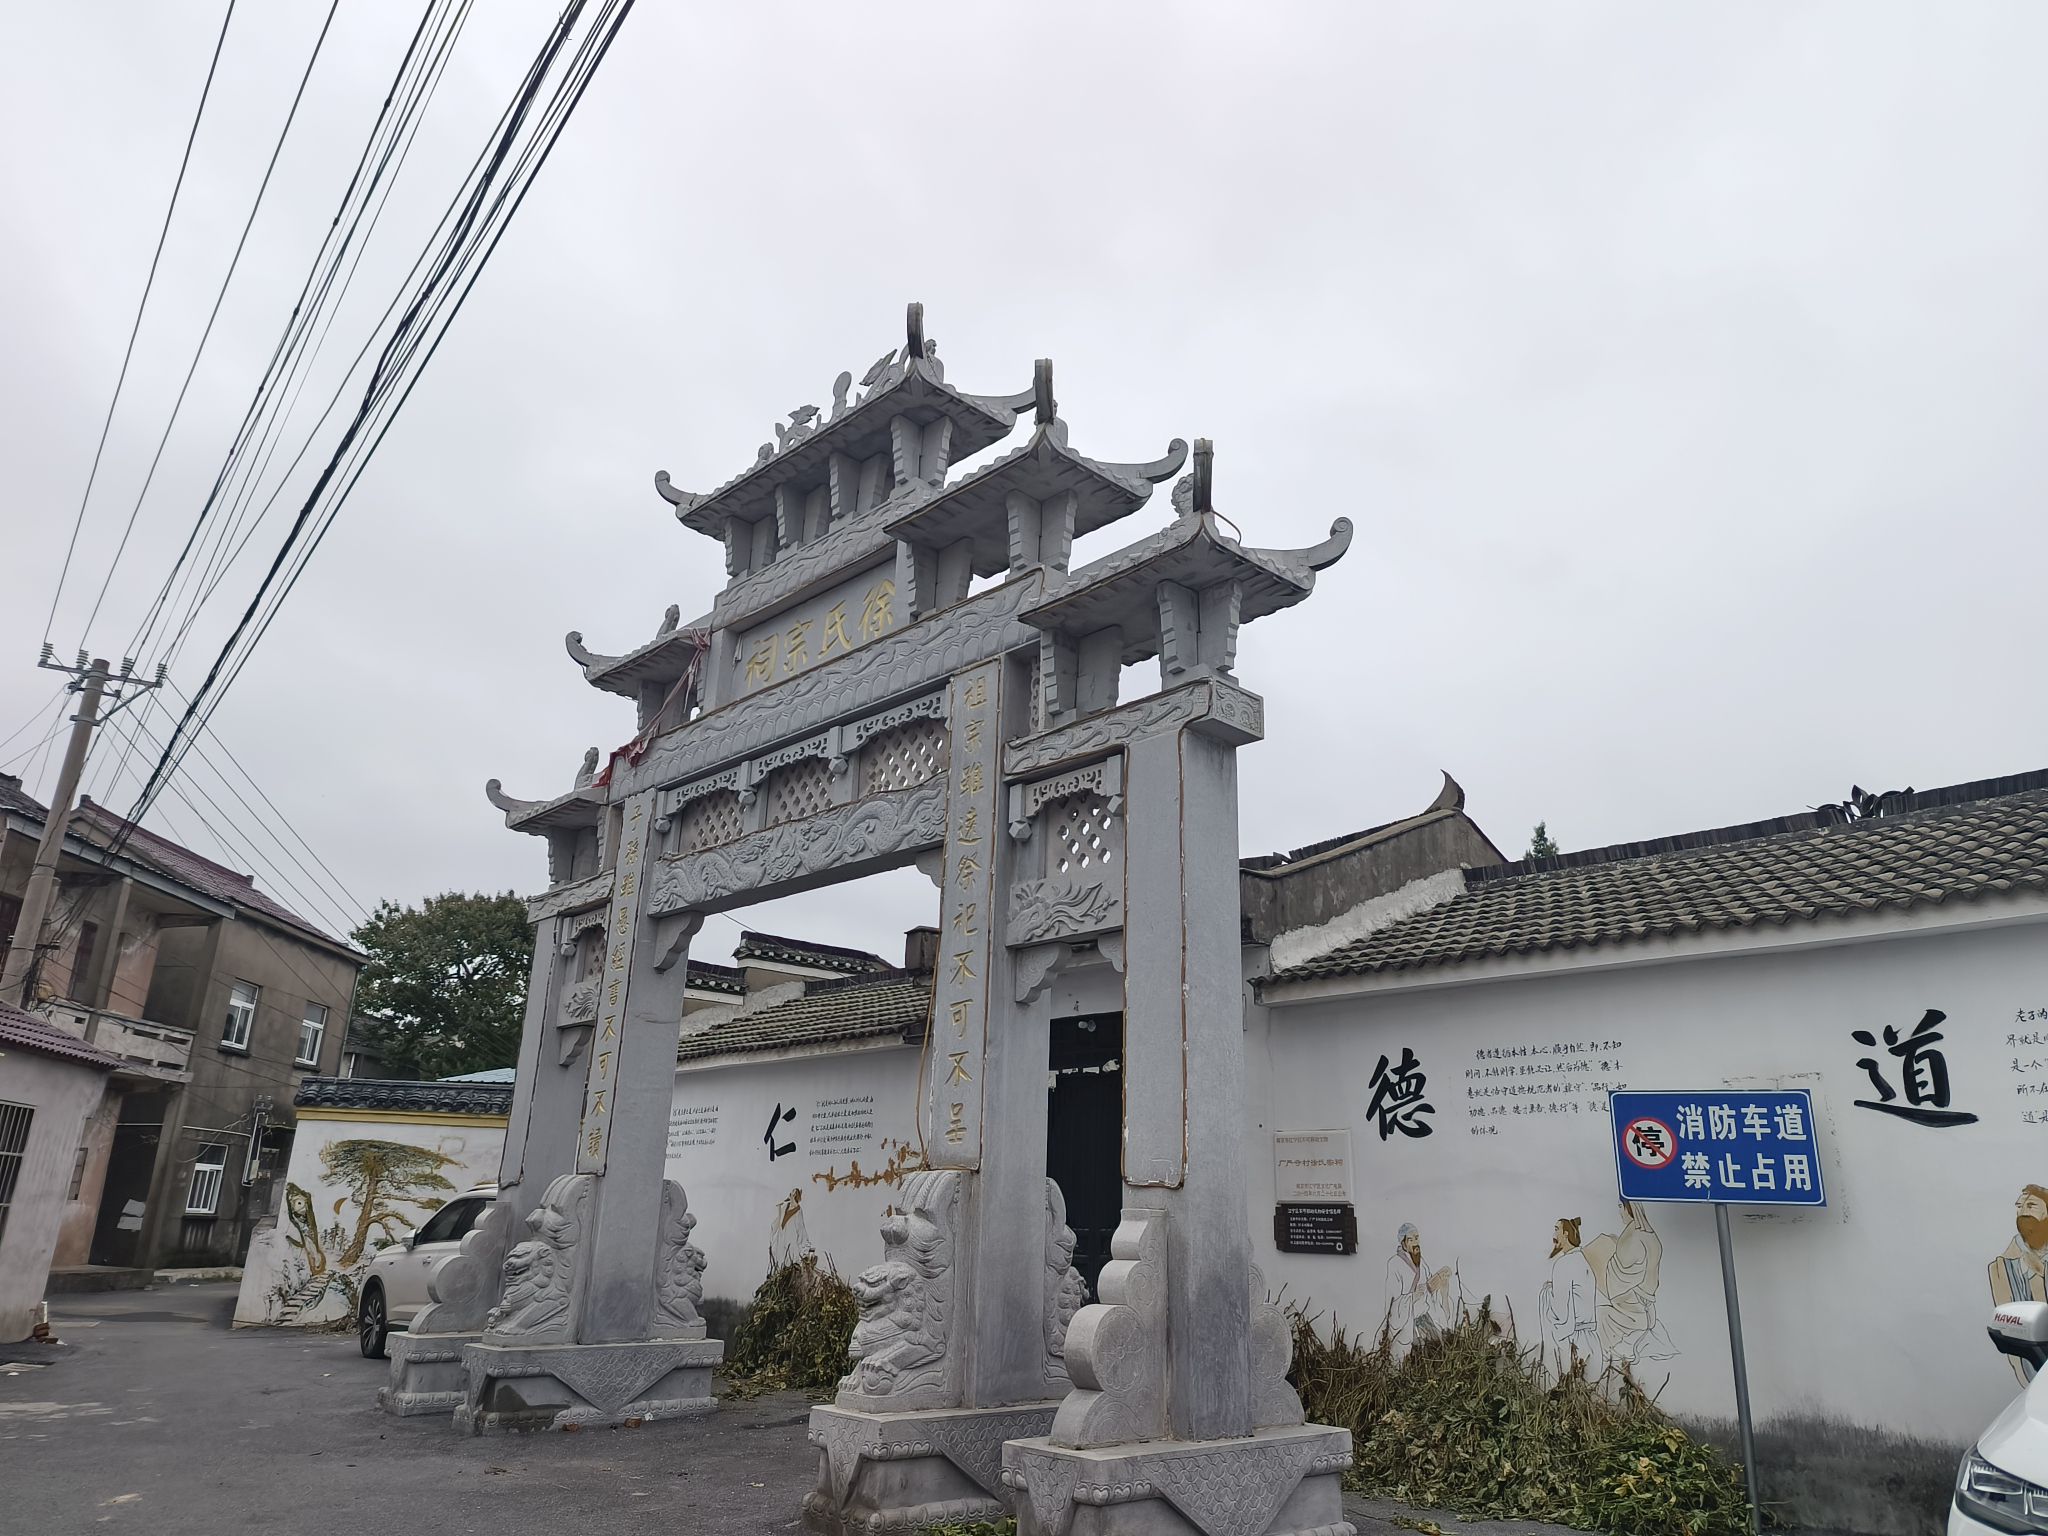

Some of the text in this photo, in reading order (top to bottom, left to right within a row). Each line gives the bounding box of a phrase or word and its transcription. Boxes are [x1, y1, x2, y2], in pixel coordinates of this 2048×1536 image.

[745, 578, 896, 688] 徐氏宗祠
[1851, 1009, 1979, 1128] 道
[1366, 1048, 1435, 1141] 德
[764, 1103, 796, 1161] 仁
[1631, 1126, 1665, 1156] 停
[1676, 1104, 1807, 1141] 消防车道
[1681, 1152, 1812, 1191] 禁止占用
[1995, 1313, 2023, 1326] HAVAL
